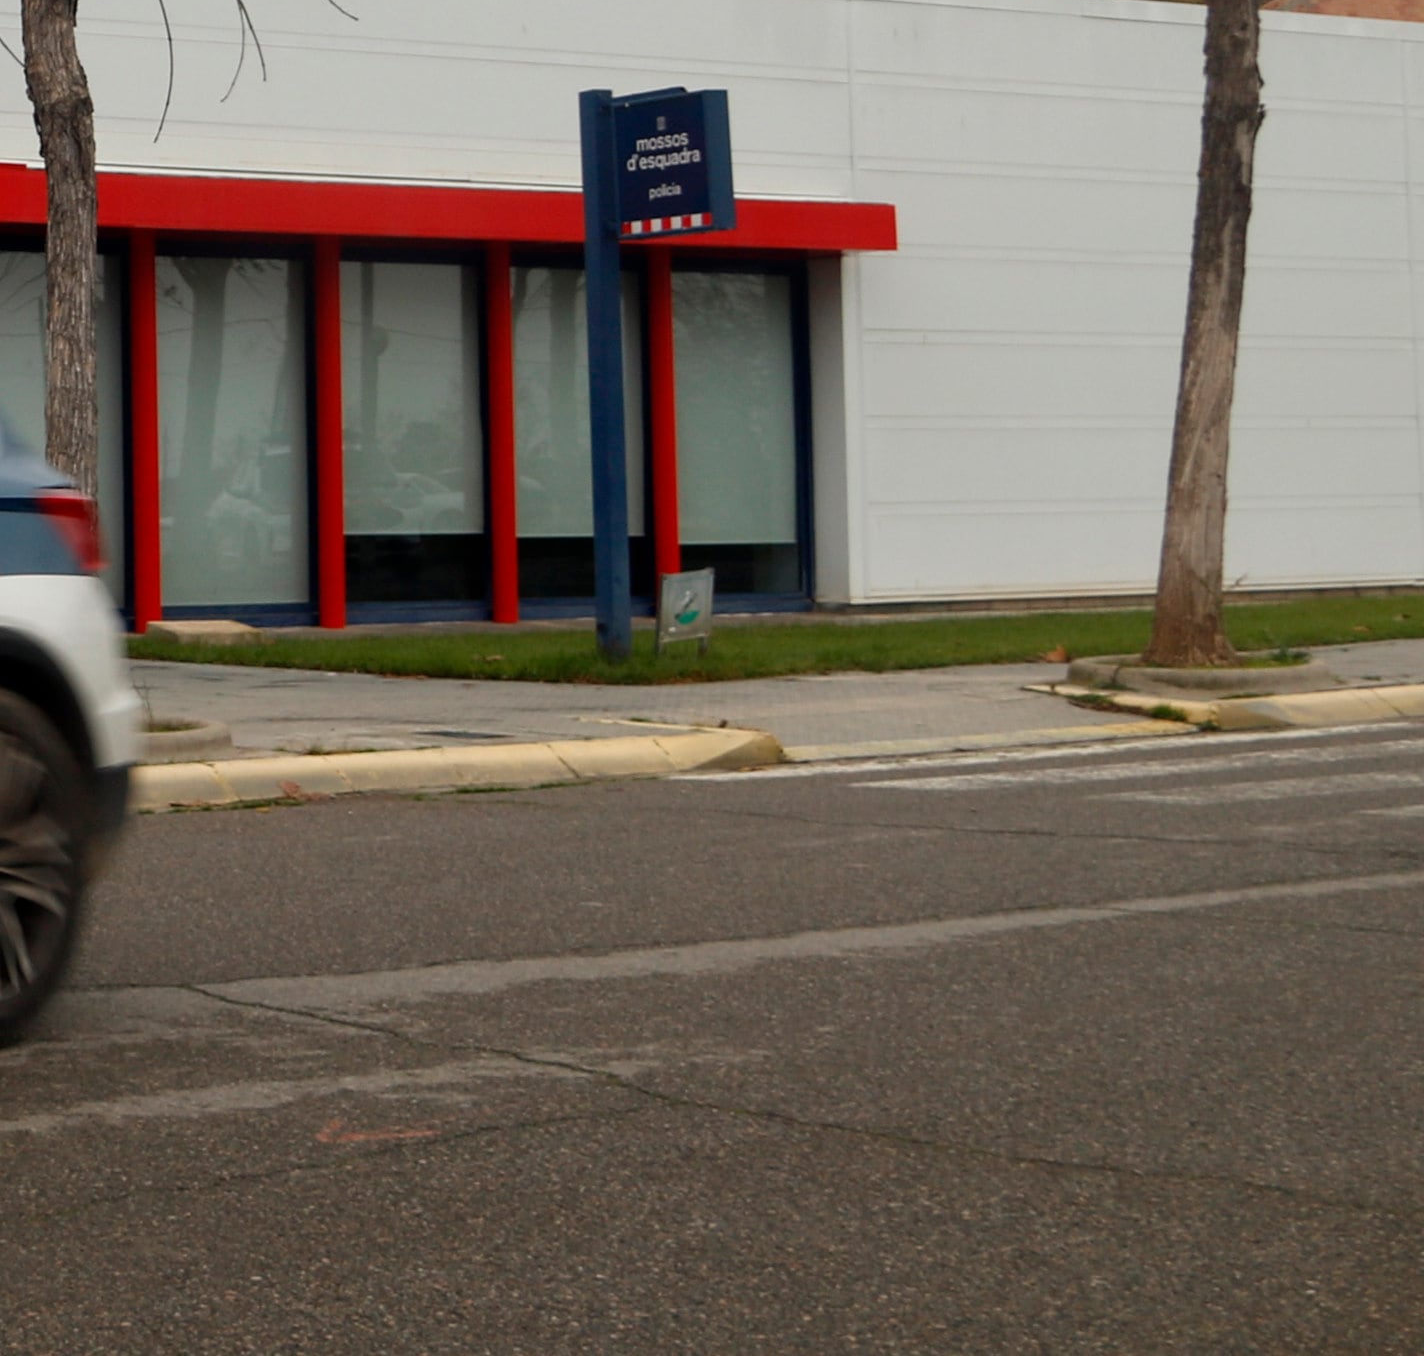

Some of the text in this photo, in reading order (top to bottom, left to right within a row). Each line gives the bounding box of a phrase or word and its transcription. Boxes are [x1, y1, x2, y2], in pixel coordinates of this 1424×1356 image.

[636, 132, 689, 152] mossos
[626, 147, 701, 172] d'esquadra
[649, 183, 682, 200] policia
